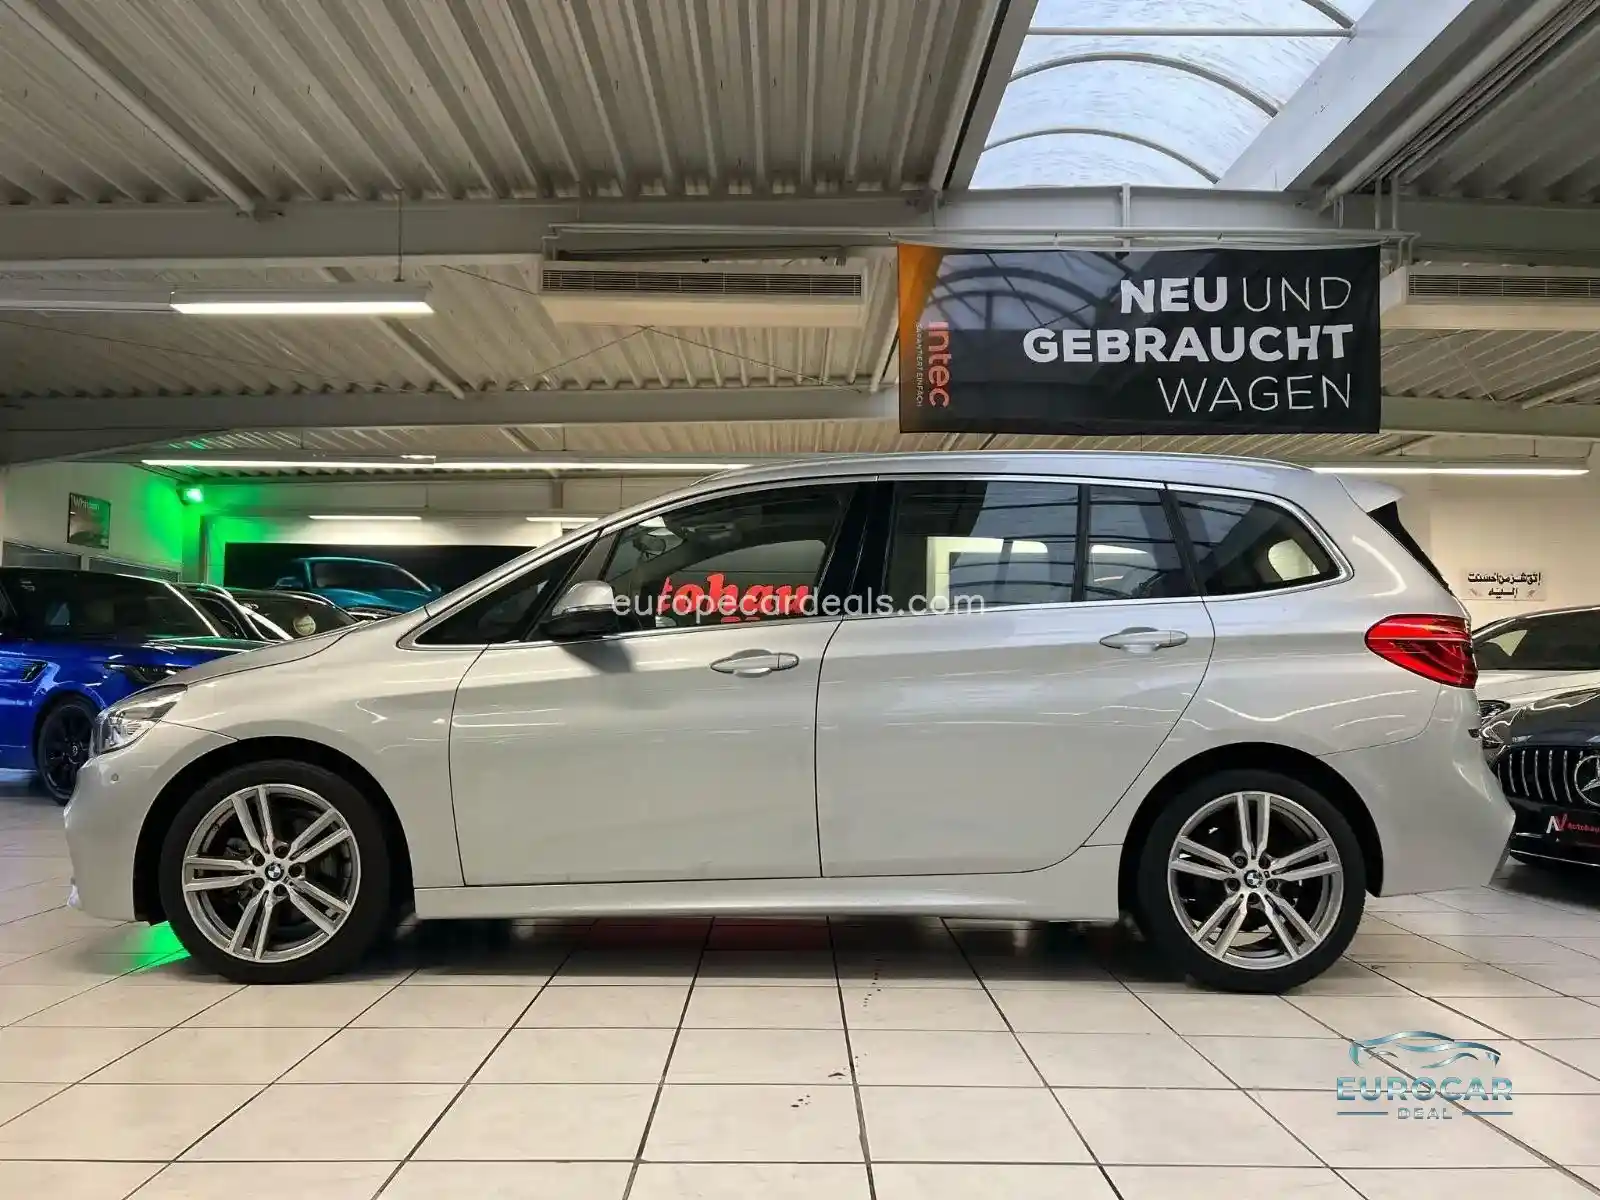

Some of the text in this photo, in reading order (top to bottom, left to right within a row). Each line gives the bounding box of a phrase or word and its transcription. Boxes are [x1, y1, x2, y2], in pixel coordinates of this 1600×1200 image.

[1120, 276, 1352, 314] NEU UND
[1023, 323, 1354, 363] GEBRAUCHT
[916, 372, 925, 407] EINFACH
[1157, 373, 1351, 413] WAGEN
